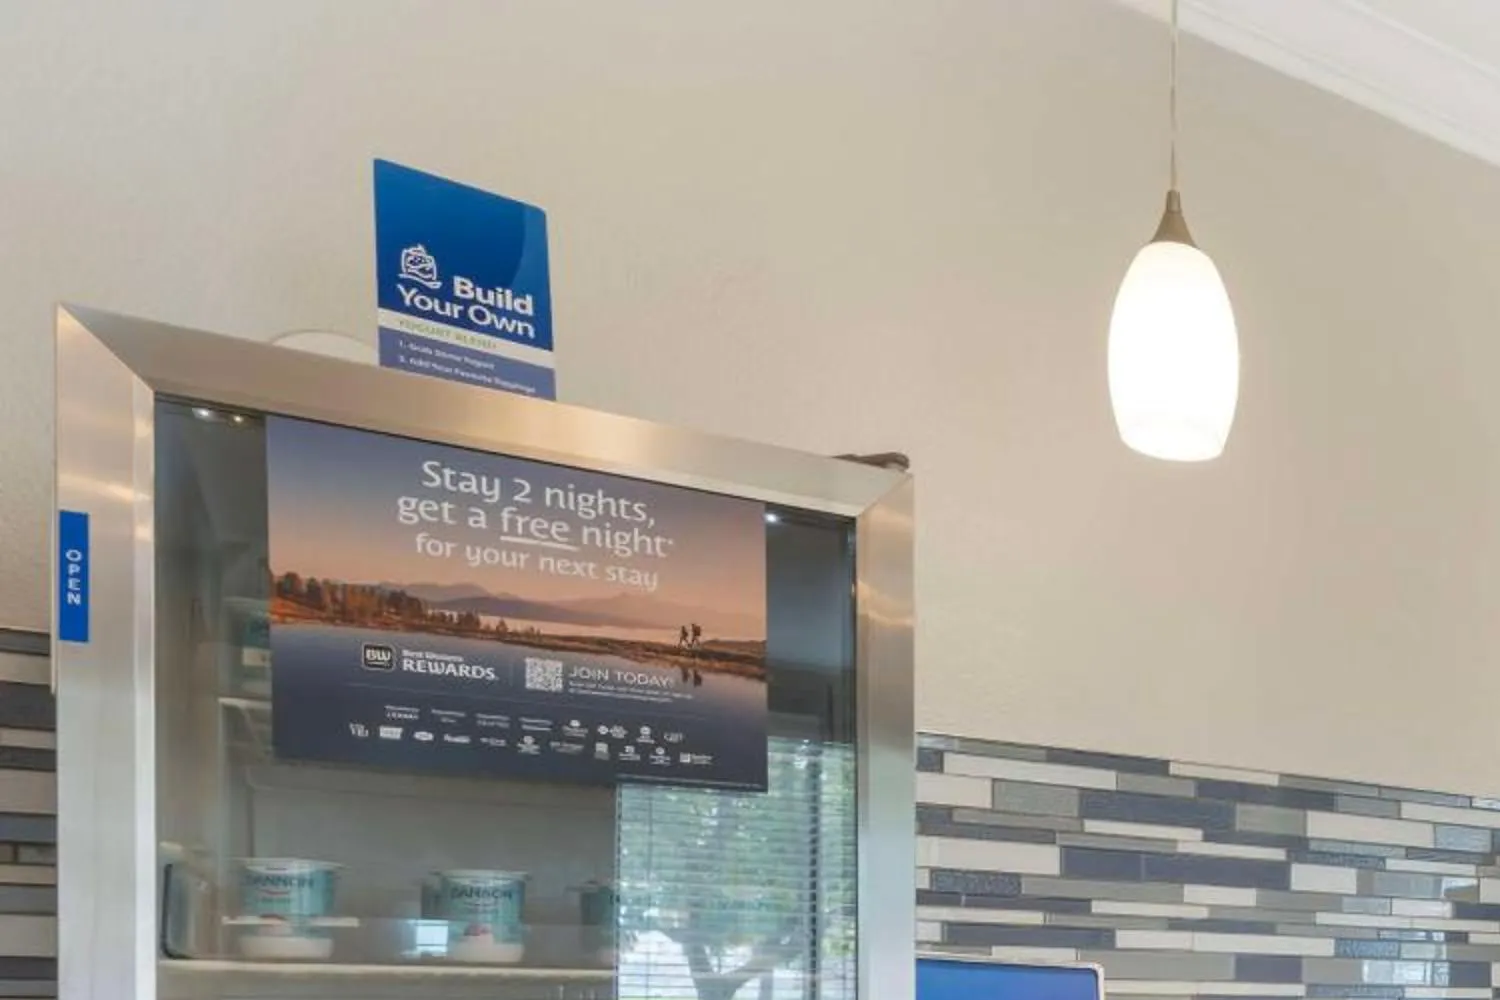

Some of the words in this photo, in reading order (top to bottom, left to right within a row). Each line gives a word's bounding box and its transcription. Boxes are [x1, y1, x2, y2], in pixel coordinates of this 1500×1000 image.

[397, 283, 465, 318] Your
[468, 305, 535, 339] Own
[453, 275, 533, 317] Build
[397, 495, 456, 525] get
[468, 508, 487, 529] a
[500, 506, 571, 542] free
[422, 460, 500, 503] Stay
[513, 478, 532, 503] 2
[545, 484, 655, 529] nights,
[65, 549, 82, 606] OPEN
[415, 532, 458, 557] for
[465, 544, 529, 568] your
[539, 553, 599, 580] next
[605, 563, 659, 592] stay
[366, 647, 391, 663] BW
[568, 665, 609, 680] JOIN
